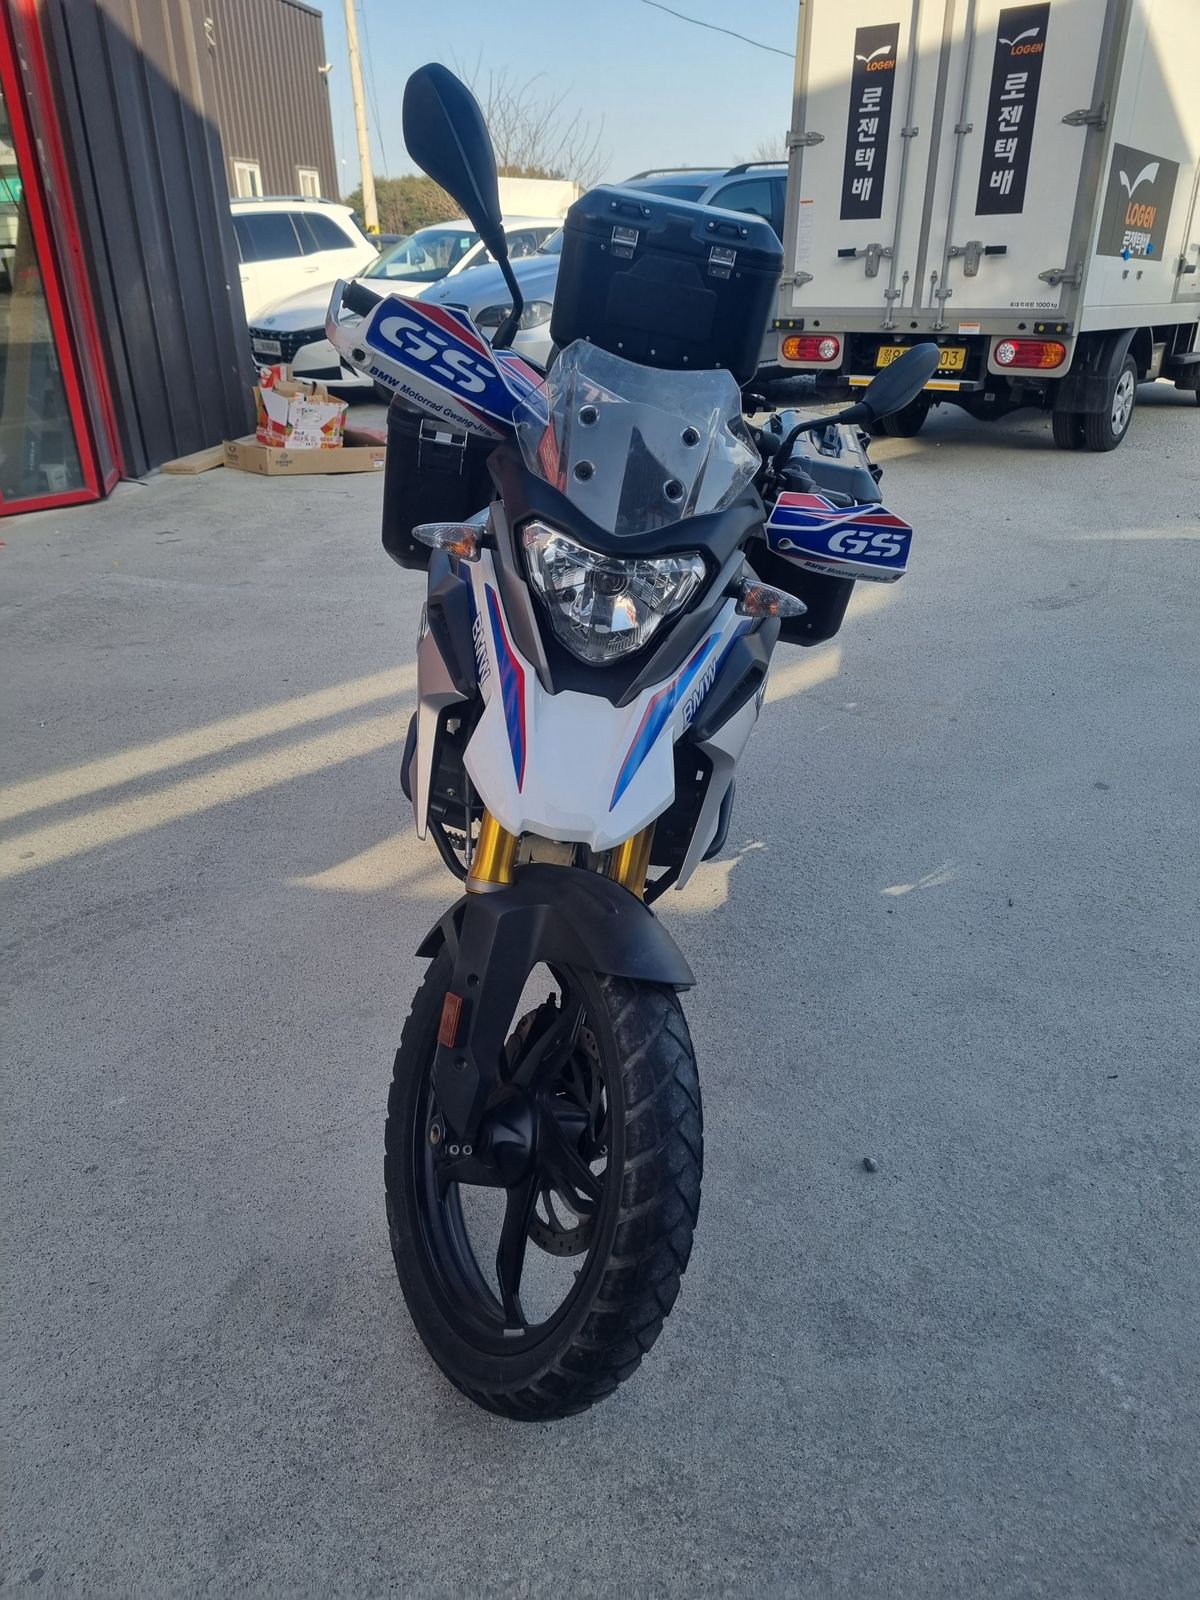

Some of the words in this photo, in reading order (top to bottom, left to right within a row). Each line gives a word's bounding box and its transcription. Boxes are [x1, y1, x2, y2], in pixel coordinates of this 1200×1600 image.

[866, 59, 896, 72] LOGEN
[1010, 42, 1044, 56] LOGEN
[851, 87, 883, 201] 로젠택배
[988, 72, 1028, 195] 로젠택배
[1125, 202, 1157, 229] LOGEN
[1120, 230, 1152, 256] 로젠택배
[378, 315, 497, 394] GS
[369, 366, 400, 387] BMW
[400, 384, 444, 412] Motorrad
[443, 408, 487, 433] Gwang-Ju
[804, 561, 828, 572] BMW
[827, 529, 907, 557] GS
[472, 611, 492, 688] BMW
[682, 656, 718, 730] BMW
